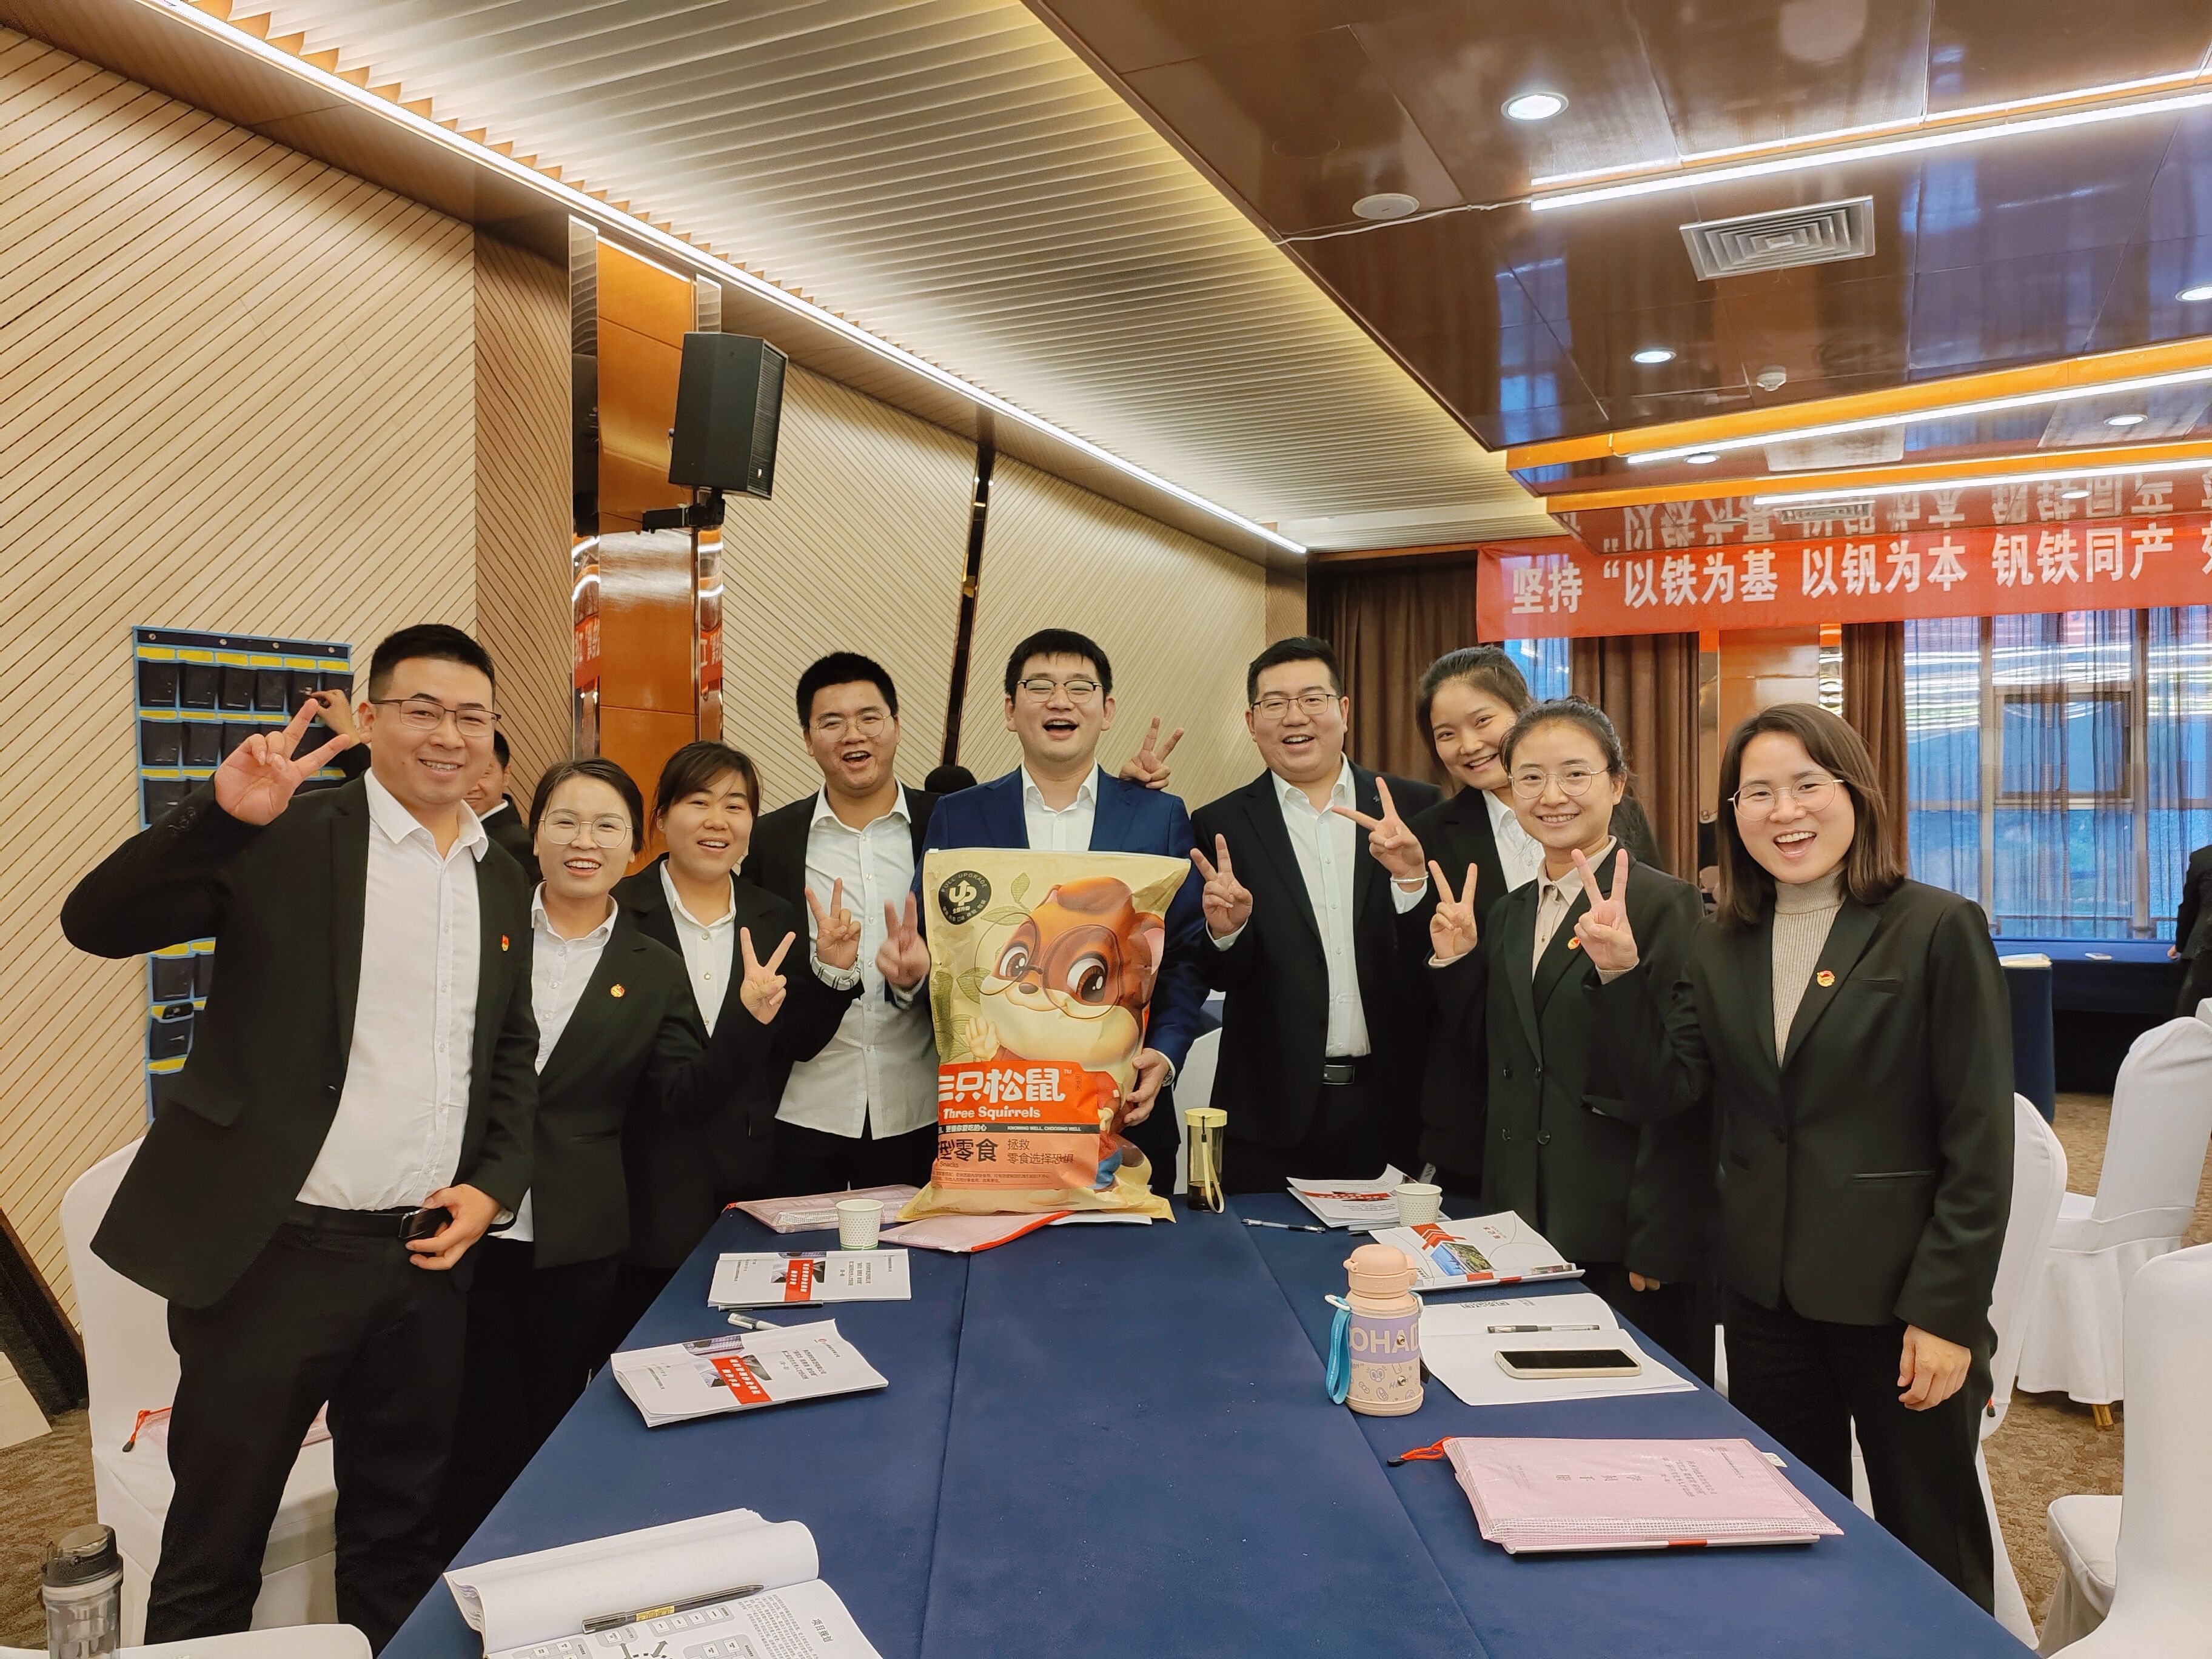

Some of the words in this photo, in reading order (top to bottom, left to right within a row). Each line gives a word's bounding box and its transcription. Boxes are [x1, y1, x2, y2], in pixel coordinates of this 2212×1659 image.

[1512, 561, 1583, 614] 坚持
[1603, 548, 1778, 608] “以铁为基
[1802, 535, 1968, 598] 以钒为本
[1991, 522, 2174, 588] 钒铁同产
[941, 877, 956, 893] FULL
[958, 873, 988, 888] UPGRADE
[938, 1068, 1066, 1104] 三只松鼠
[943, 1108, 975, 1119] Three
[977, 1105, 1041, 1121] Squirrels
[939, 1138, 998, 1162] 型零食
[1007, 1138, 1030, 1150] 拯救
